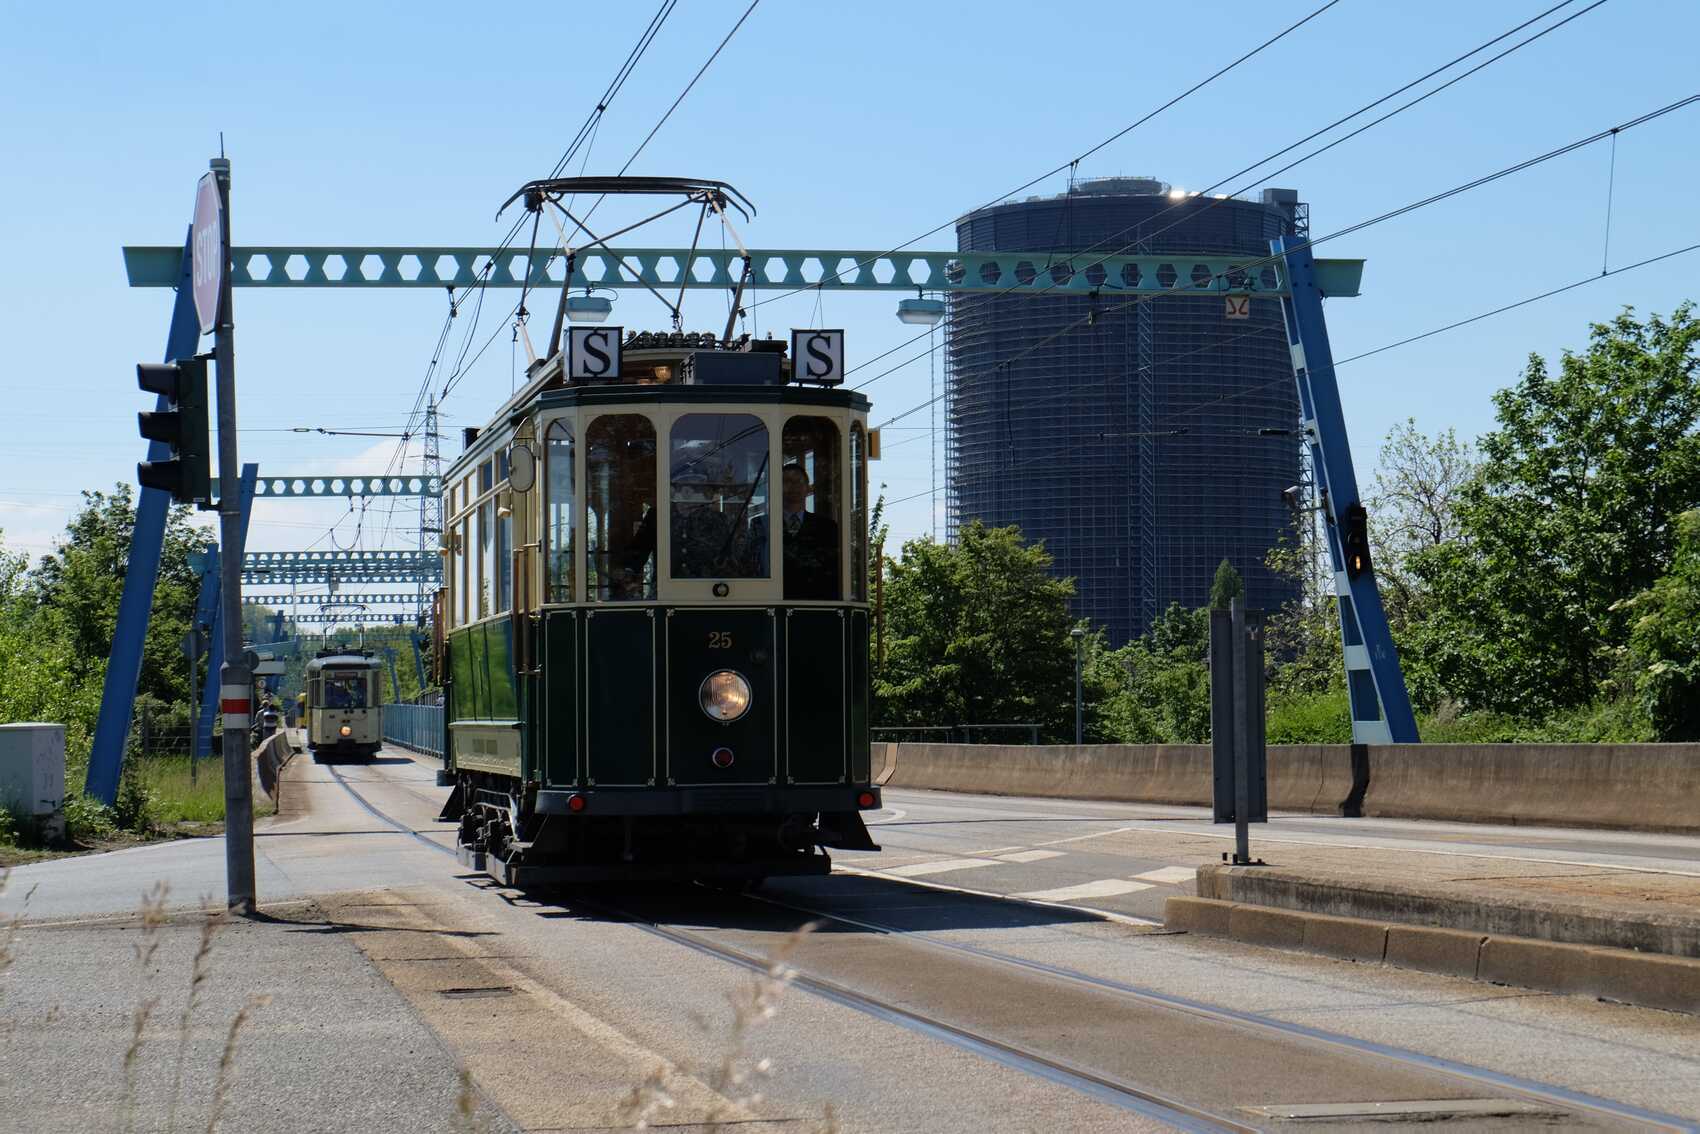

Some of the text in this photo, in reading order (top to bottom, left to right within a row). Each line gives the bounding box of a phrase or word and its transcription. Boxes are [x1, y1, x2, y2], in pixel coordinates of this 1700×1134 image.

[196, 222, 218, 287] STOP
[583, 331, 610, 376] S
[807, 334, 834, 377] S
[708, 631, 733, 649] 25
